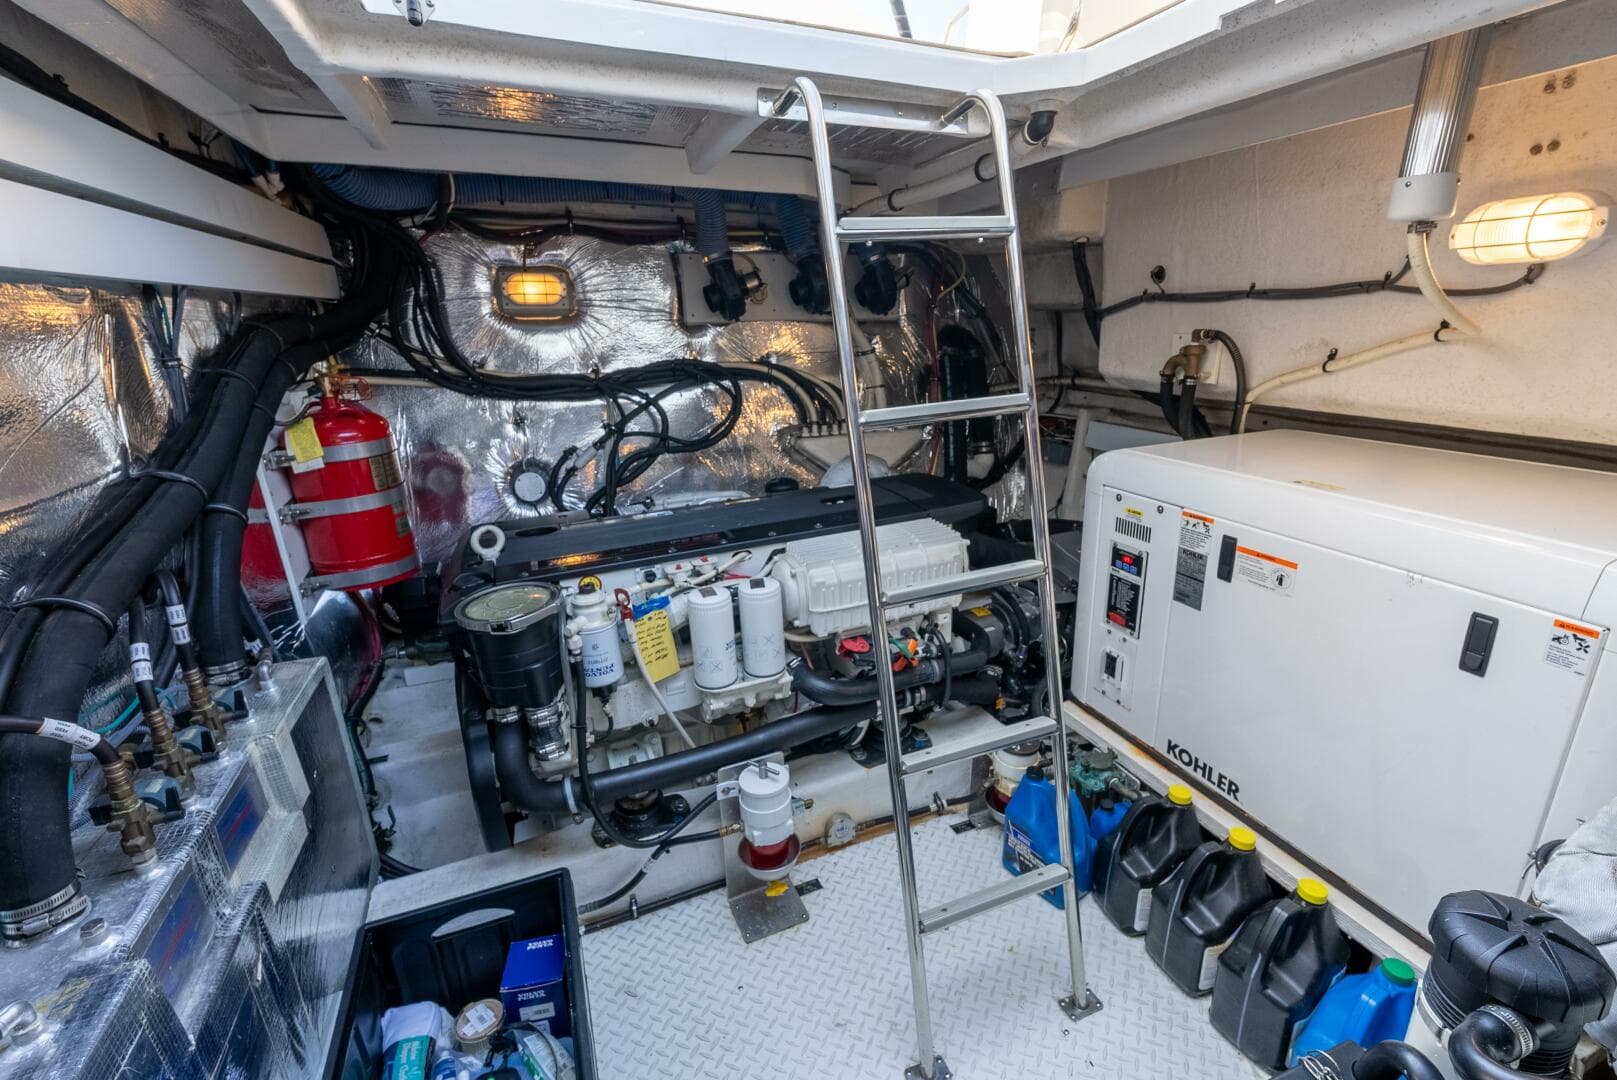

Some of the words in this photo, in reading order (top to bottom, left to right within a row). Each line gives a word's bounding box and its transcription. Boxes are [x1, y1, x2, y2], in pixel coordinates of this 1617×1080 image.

[1182, 549, 1204, 560] KOHLER
[584, 664, 614, 673] PENTA
[585, 669, 614, 678] VOLVO
[1167, 739, 1240, 802] KOHLER
